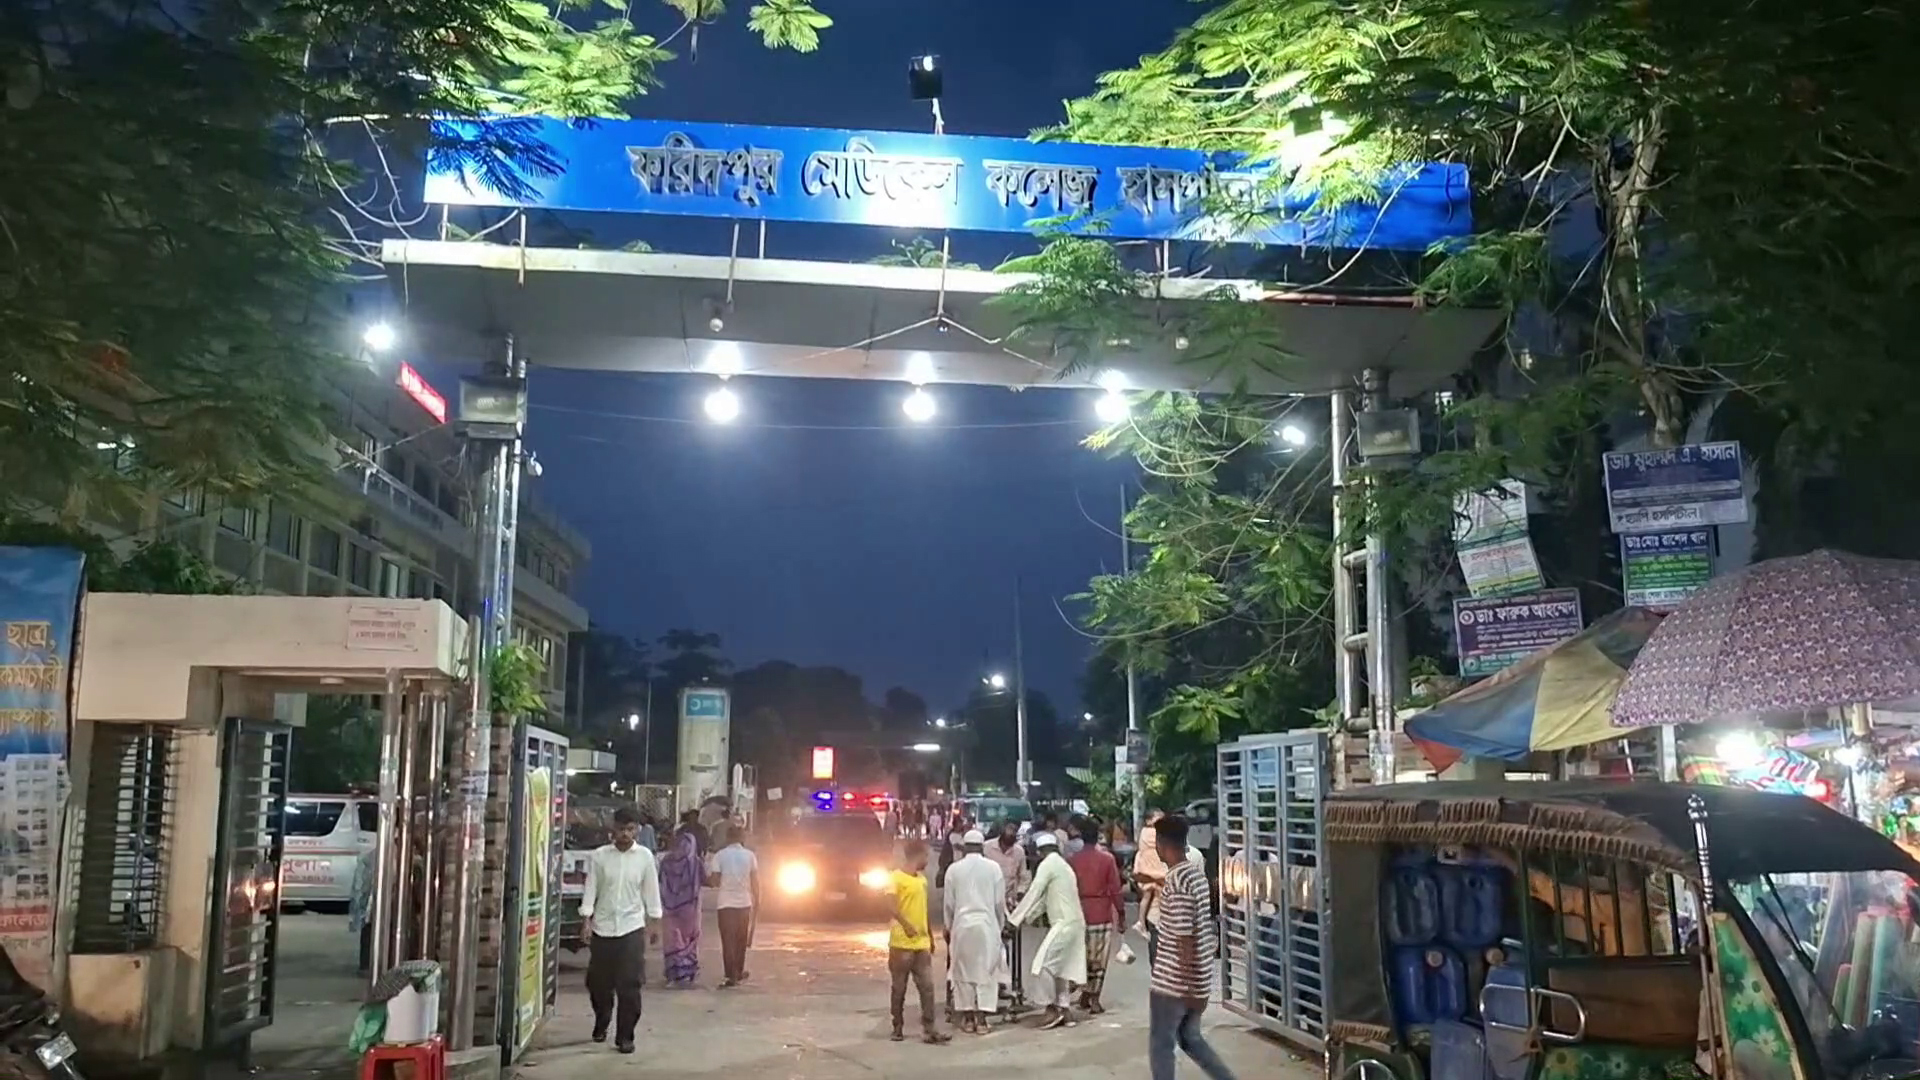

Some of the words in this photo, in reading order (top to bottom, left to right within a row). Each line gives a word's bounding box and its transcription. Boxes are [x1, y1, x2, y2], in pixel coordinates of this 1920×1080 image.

[625, 130, 784, 207] ফরিদপুর
[801, 136, 964, 206] মেডিকেল
[983, 159, 1100, 211] কলেজ
[1609, 454, 1630, 470] ডাঃ
[1700, 444, 1735, 461] হাসান
[1474, 609, 1495, 623] ডাঃ
[1495, 605, 1530, 621] ফারুক
[5, 620, 57, 651] ছাত্র,
